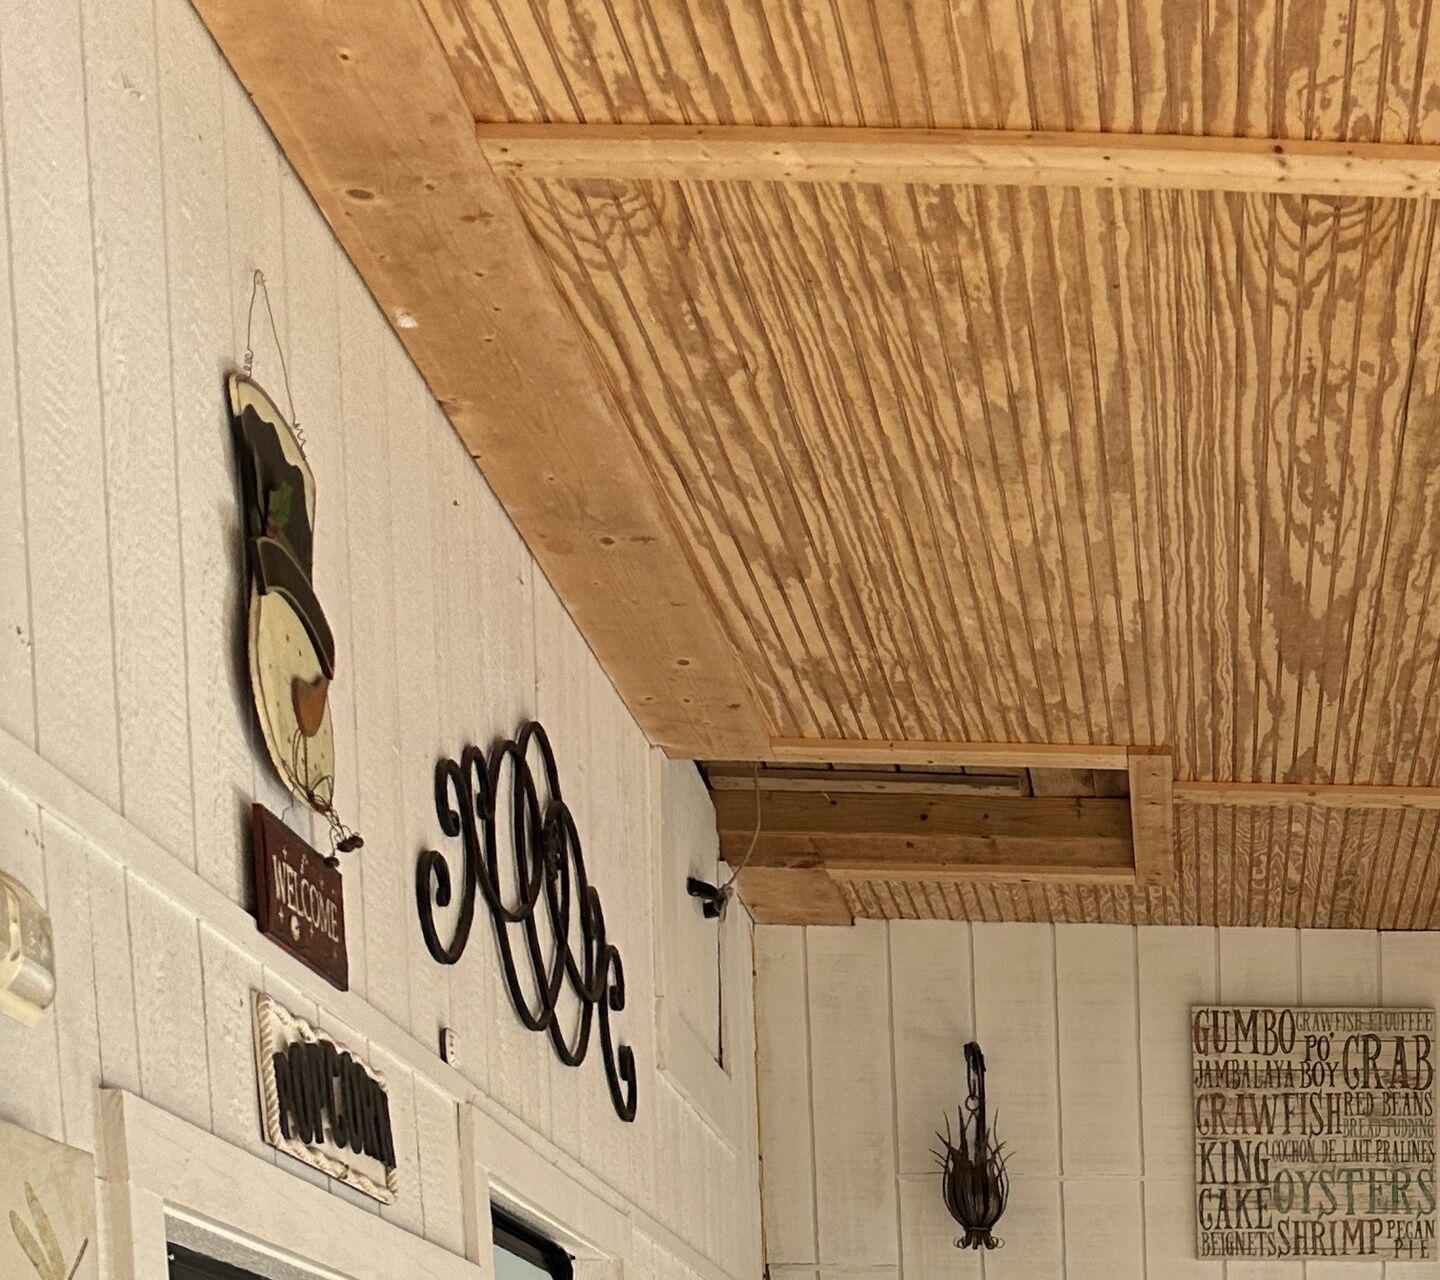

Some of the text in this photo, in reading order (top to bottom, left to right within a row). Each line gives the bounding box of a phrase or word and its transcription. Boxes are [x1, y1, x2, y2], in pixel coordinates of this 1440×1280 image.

[272, 854, 339, 943] WELCOME
[1194, 1008, 1296, 1056] GUMBO
[1296, 1011, 1361, 1032] CRAWFISH
[1304, 1032, 1334, 1062] PO'
[1194, 1060, 1295, 1089] JAMBALAYA
[1299, 1061, 1339, 1088] BOY
[1342, 1033, 1434, 1091] CRAB
[1196, 1089, 1342, 1136] CRAWFISH
[1343, 1090, 1433, 1117] RED BEANS
[1343, 1118, 1434, 1138] BREAD PUDDING
[1198, 1140, 1270, 1185] KING
[1271, 1139, 1372, 1164] COCHON DE LAIT
[1375, 1139, 1435, 1164] PRALINES
[1273, 1167, 1436, 1218] OYSTERS
[1198, 1187, 1273, 1231] CAKE
[1201, 1231, 1277, 1257] BEIGNETS
[1277, 1217, 1383, 1258] SHRIMP
[1386, 1219, 1435, 1240] PECAN
[1394, 1238, 1430, 1259] PIE
